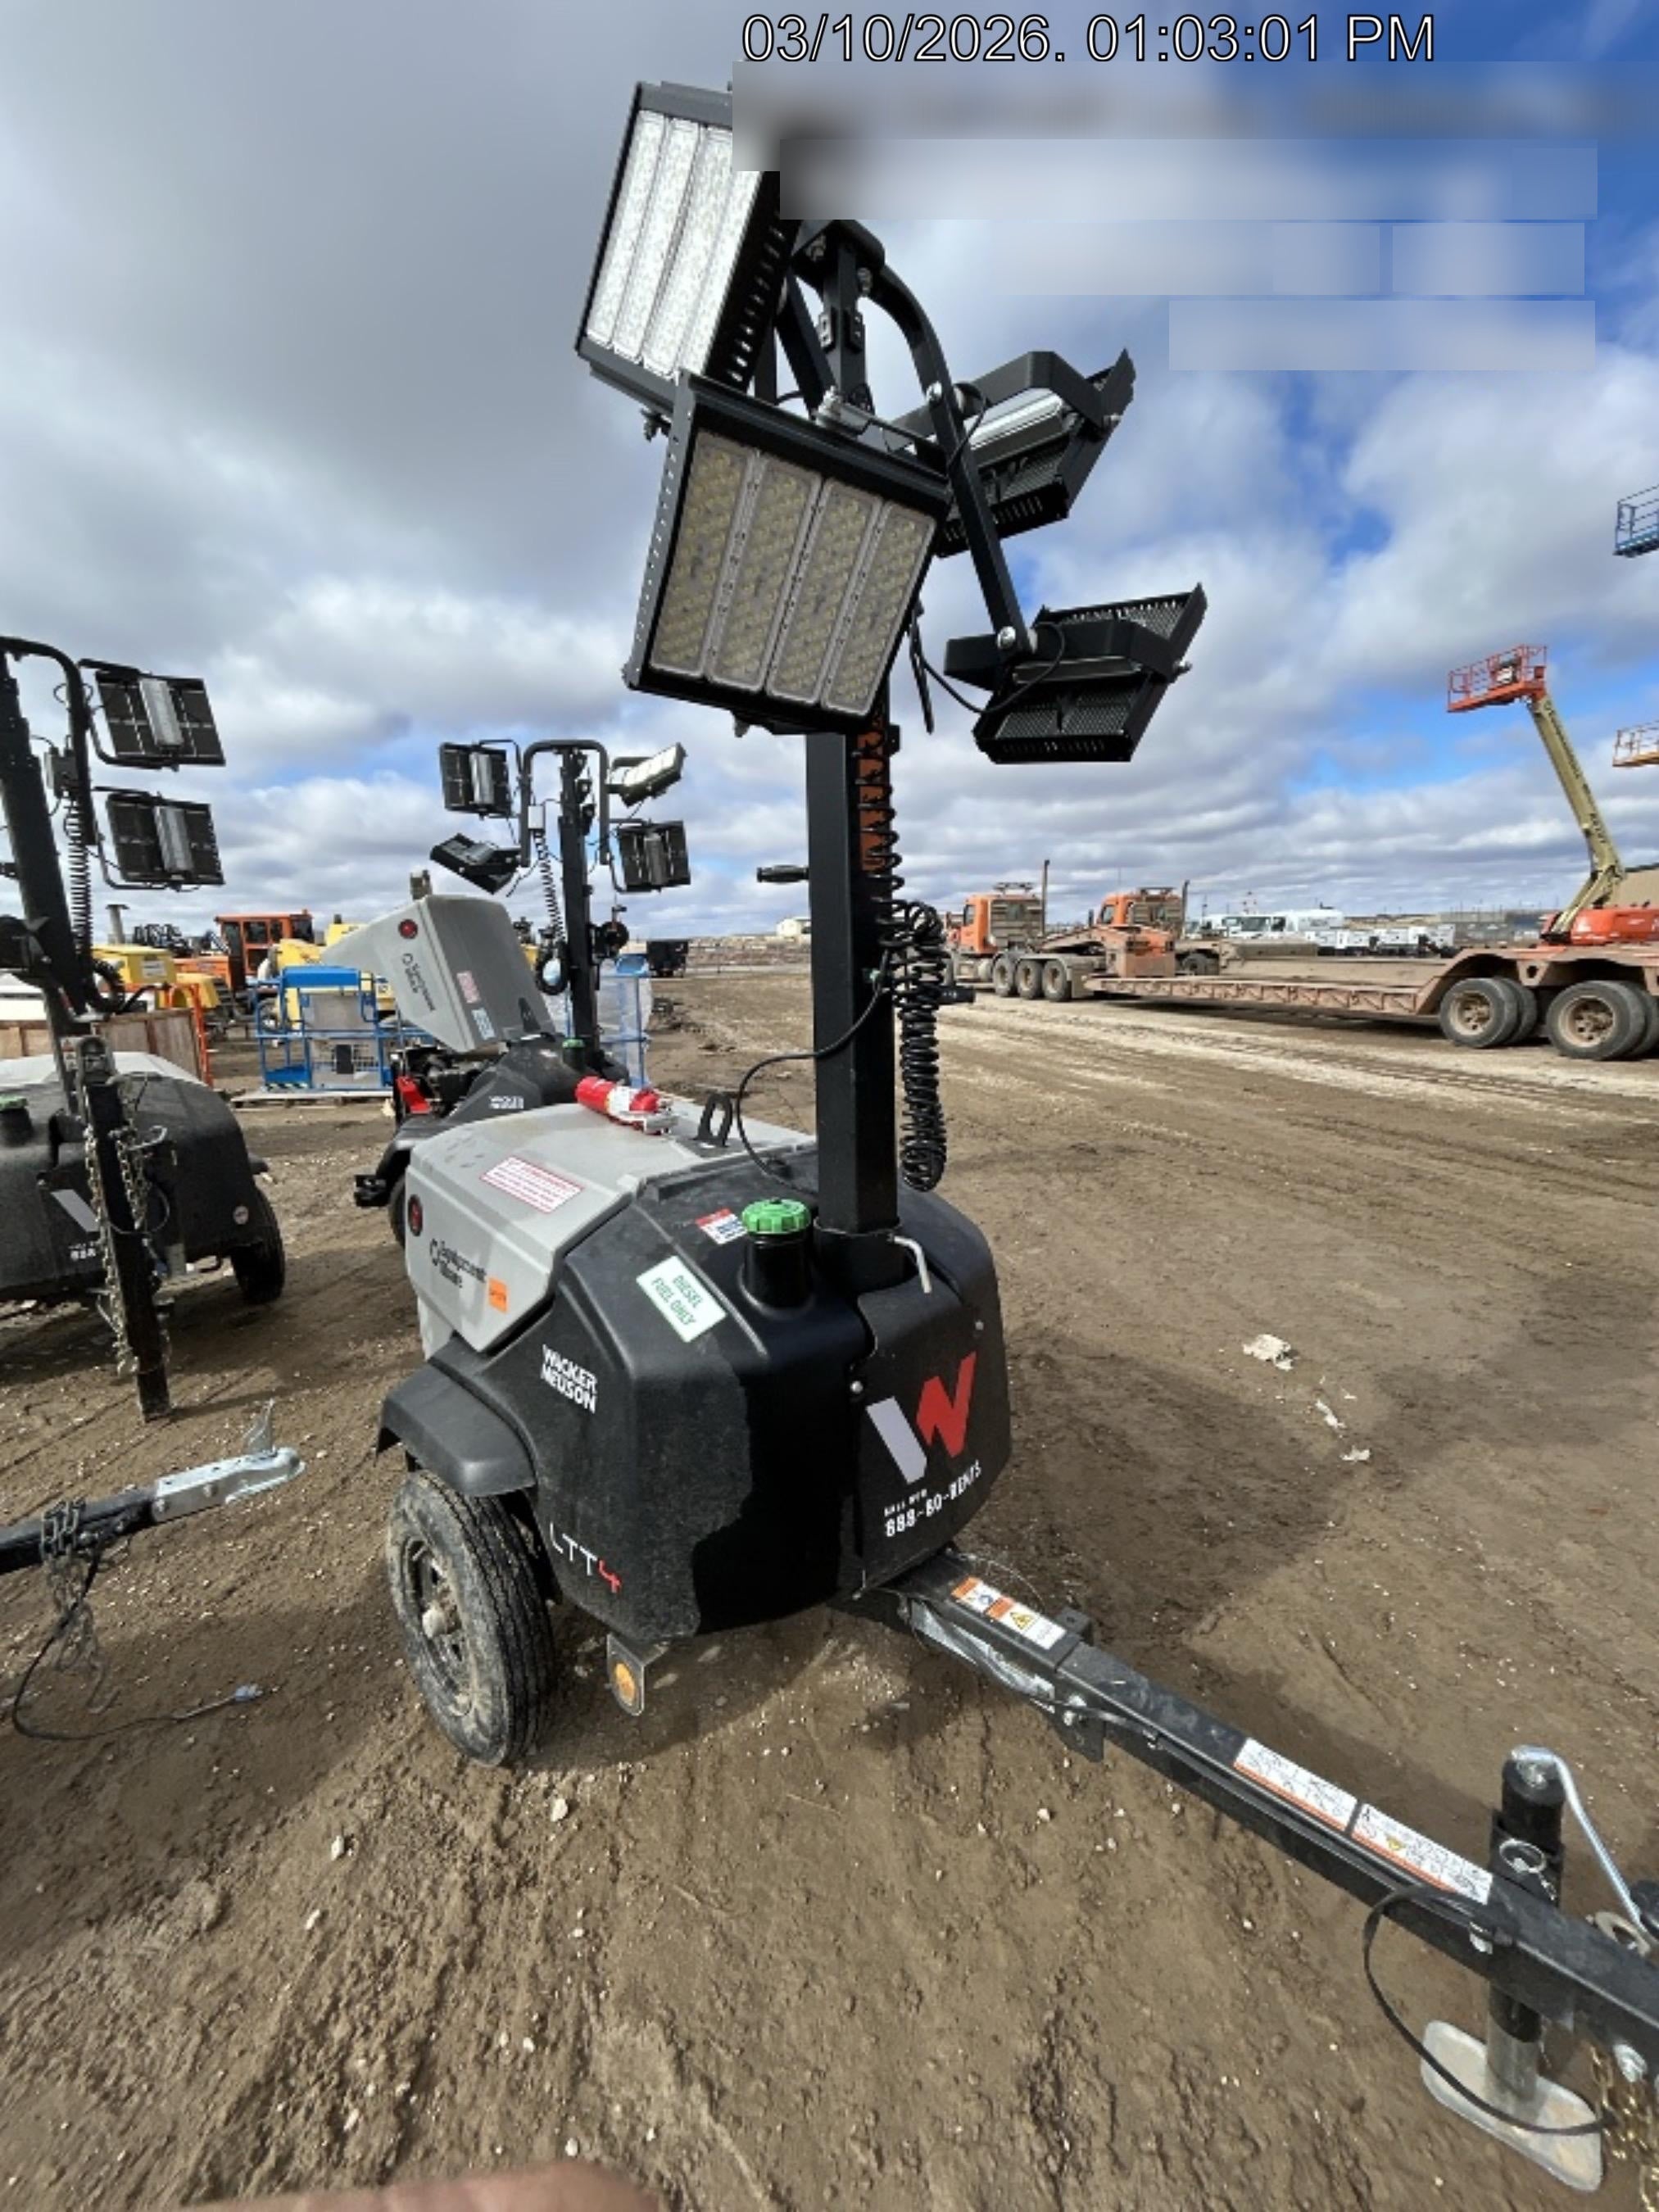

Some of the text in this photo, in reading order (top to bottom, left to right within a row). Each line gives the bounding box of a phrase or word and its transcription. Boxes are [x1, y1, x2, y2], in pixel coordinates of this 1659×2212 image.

[651, 1277, 696, 1325] FUEL ONLY
[673, 1275, 702, 1308] DIESEL
[540, 1363, 598, 1414] NEUSON
[542, 1344, 597, 1394] WACKER
